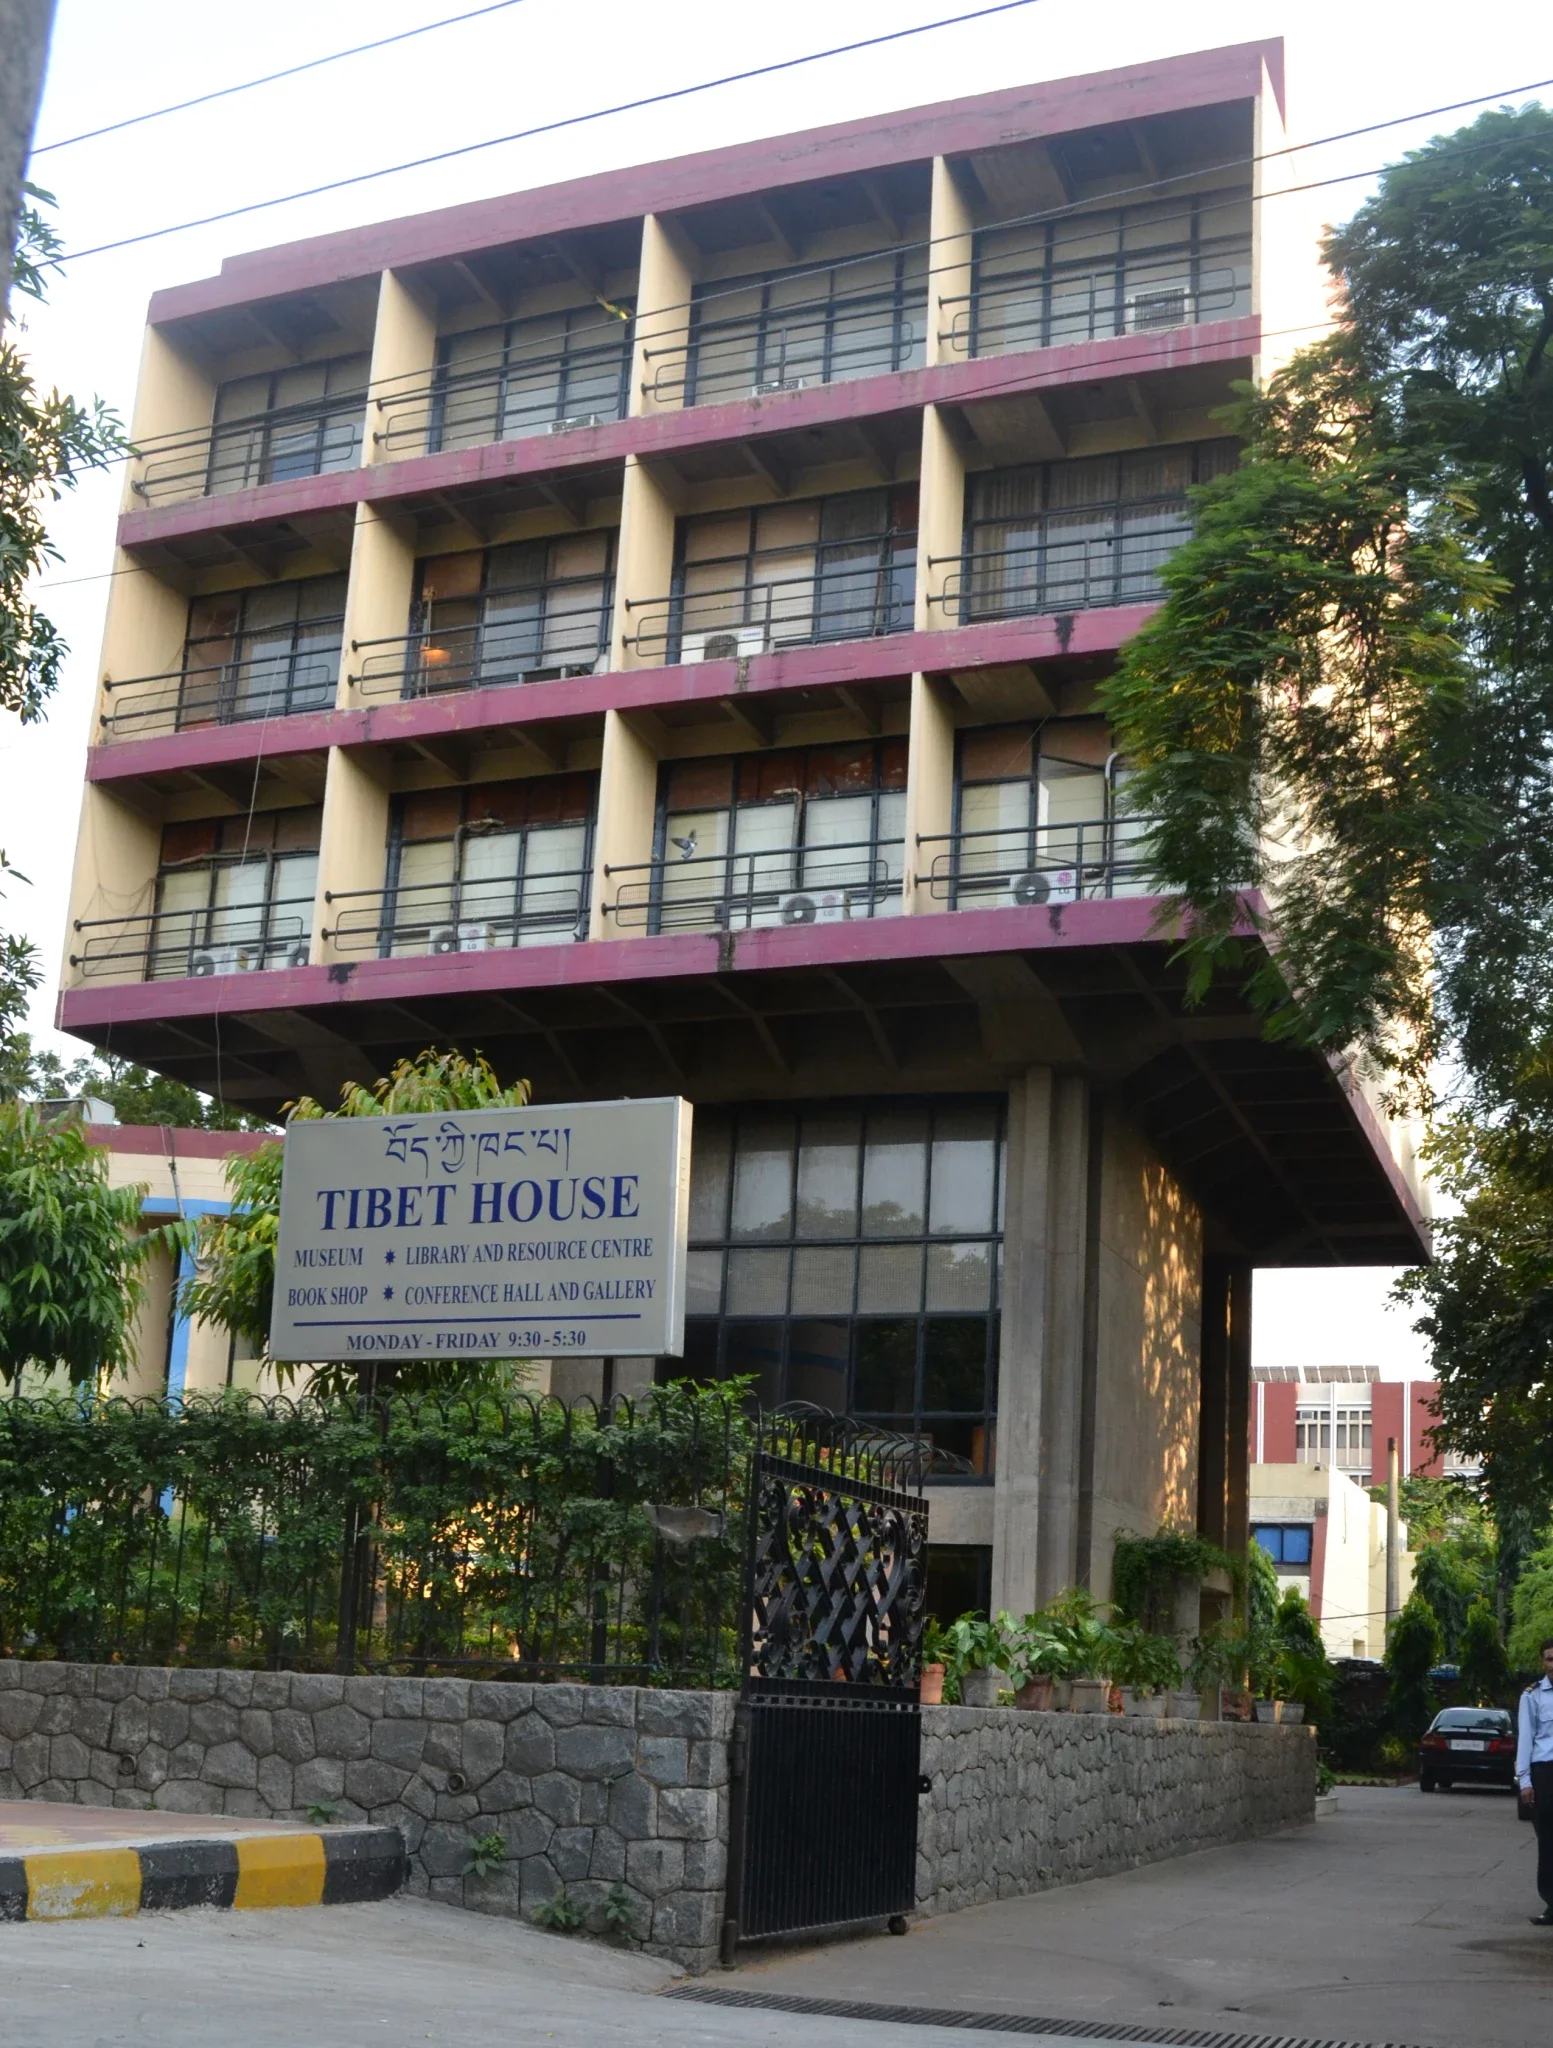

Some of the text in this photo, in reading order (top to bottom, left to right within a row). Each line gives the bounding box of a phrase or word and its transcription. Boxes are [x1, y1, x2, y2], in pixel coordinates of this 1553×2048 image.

[316, 1174, 641, 1231] TIBET HOUSE
[293, 1247, 364, 1268] MUSEUM
[405, 1237, 653, 1266] LIBRARY AND RESOURCE CENTRE
[287, 1284, 369, 1307] BOOK SHOP
[404, 1279, 657, 1306] CONFERENCE HALL AND GALLERY
